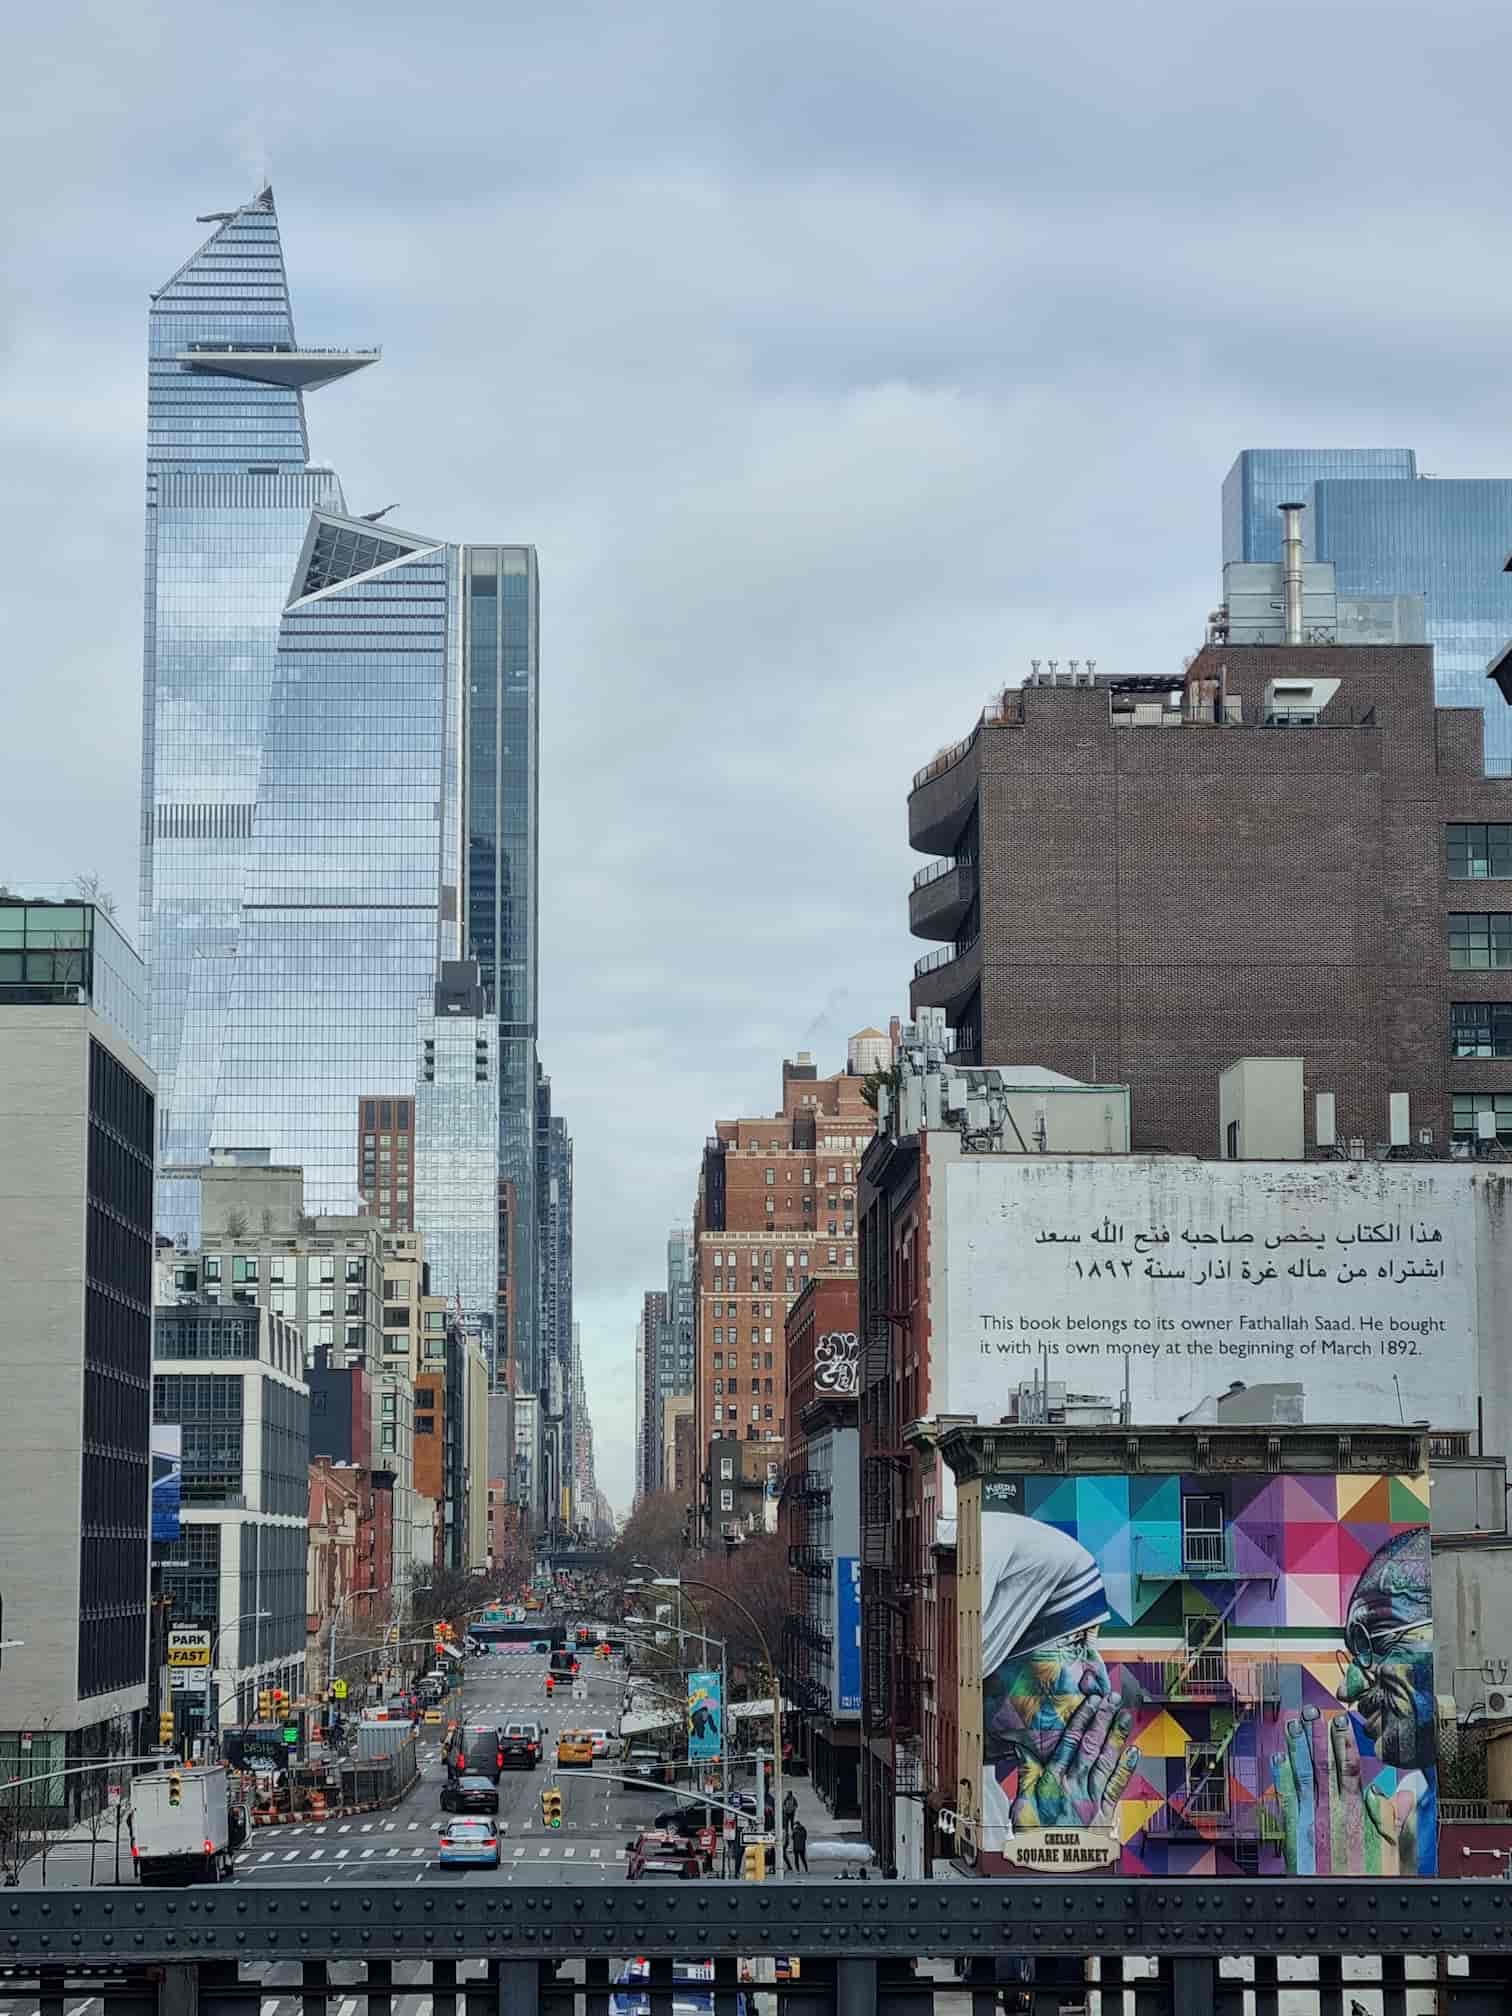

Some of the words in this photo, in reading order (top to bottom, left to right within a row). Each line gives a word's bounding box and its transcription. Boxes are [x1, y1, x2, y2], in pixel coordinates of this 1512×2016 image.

[1035, 1228, 1081, 1244] سعد
[1133, 1224, 1171, 1253] فتح
[1180, 1223, 1255, 1251] صاحبه
[1264, 1224, 1326, 1250] يخص
[1336, 1222, 1401, 1252] الكتاب
[1410, 1221, 1443, 1243] هذا
[1074, 1259, 1134, 1280] ١٨٩٢
[1143, 1257, 1186, 1279] سنة
[1192, 1258, 1232, 1286] اذار
[1241, 1260, 1279, 1286] غرة
[1337, 1263, 1368, 1284] من
[1377, 1258, 1445, 1285] اشتراه
[979, 1314, 1014, 1331] This
[1020, 1315, 1062, 1331] book
[1067, 1315, 1128, 1334] belongs
[1134, 1318, 1152, 1331] to
[1157, 1316, 1176, 1331] its
[1181, 1319, 1233, 1331] owner
[1239, 1314, 1309, 1331] Fathallah
[1314, 1315, 1356, 1331] Saad.
[1360, 1316, 1384, 1331] He
[1390, 1315, 1446, 1336] bought
[980, 1339, 991, 1355] it
[996, 1338, 1032, 1355] with
[1038, 1339, 1060, 1355] his
[1065, 1343, 1100, 1355] own
[1106, 1343, 1161, 1360] money
[1166, 1342, 1182, 1355] at
[1187, 1339, 1214, 1355] the
[1219, 1339, 1295, 1359] beginning
[1300, 1339, 1317, 1355] of
[1321, 1339, 1372, 1355] March
[1380, 1339, 1423, 1356] 1892.
[172, 1635, 206, 1645] PARK
[172, 1651, 206, 1661] FAST
[1044, 1833, 1081, 1845] CHELSEA
[1016, 1848, 1059, 1864] SQUARE
[1062, 1848, 1109, 1863] MARKET
